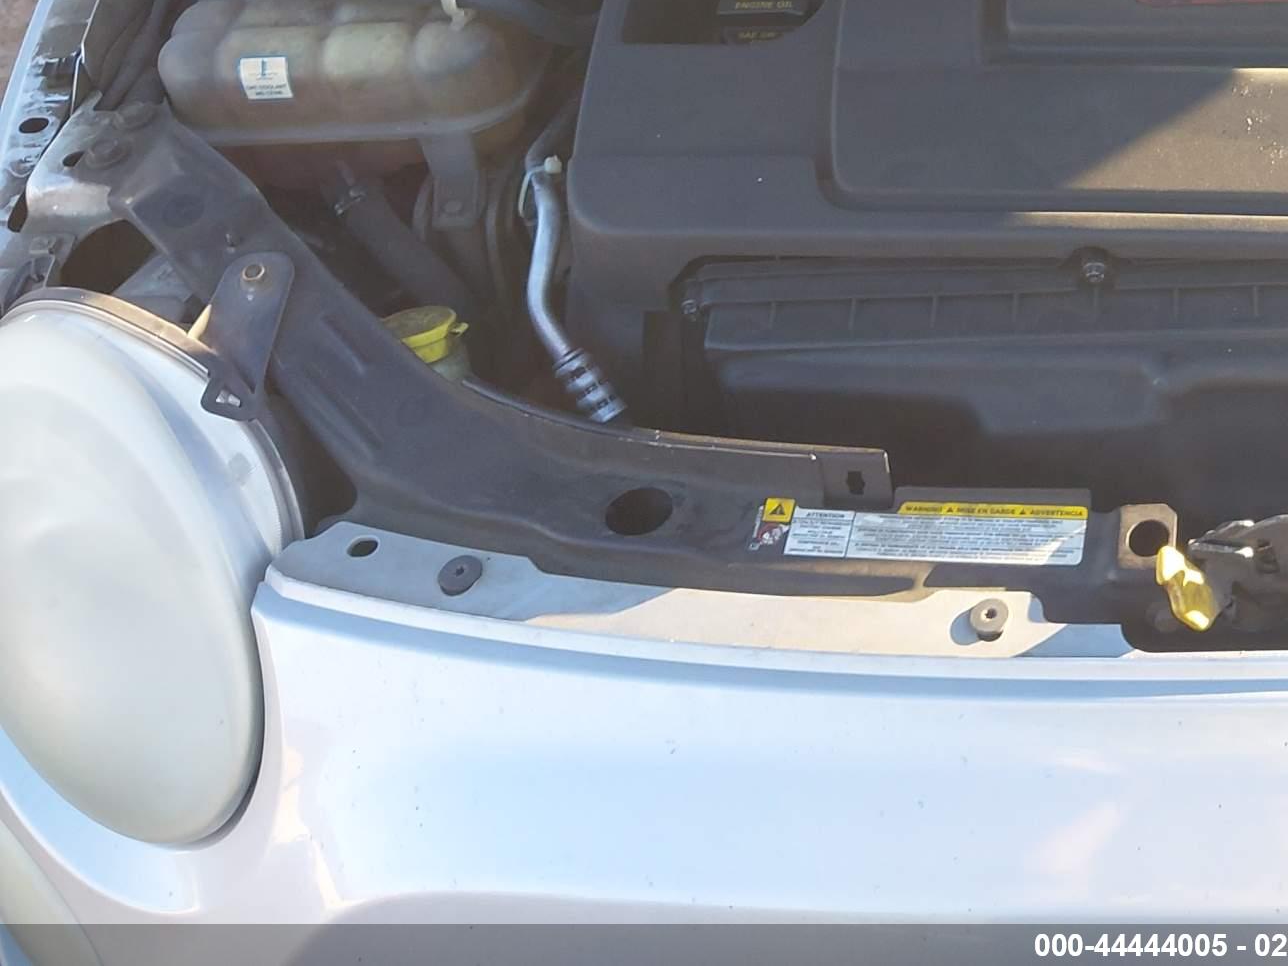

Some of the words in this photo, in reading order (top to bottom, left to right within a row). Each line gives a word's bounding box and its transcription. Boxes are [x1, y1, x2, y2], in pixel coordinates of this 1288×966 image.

[735, 1, 773, 10] ENGINE
[776, 0, 793, 9] OIL
[806, 511, 845, 519] ATTENTION
[906, 505, 943, 514] WARNING
[957, 506, 976, 514] MISE
[990, 507, 1016, 515] GARDE
[1030, 509, 1083, 517] ADVERTENCIA
